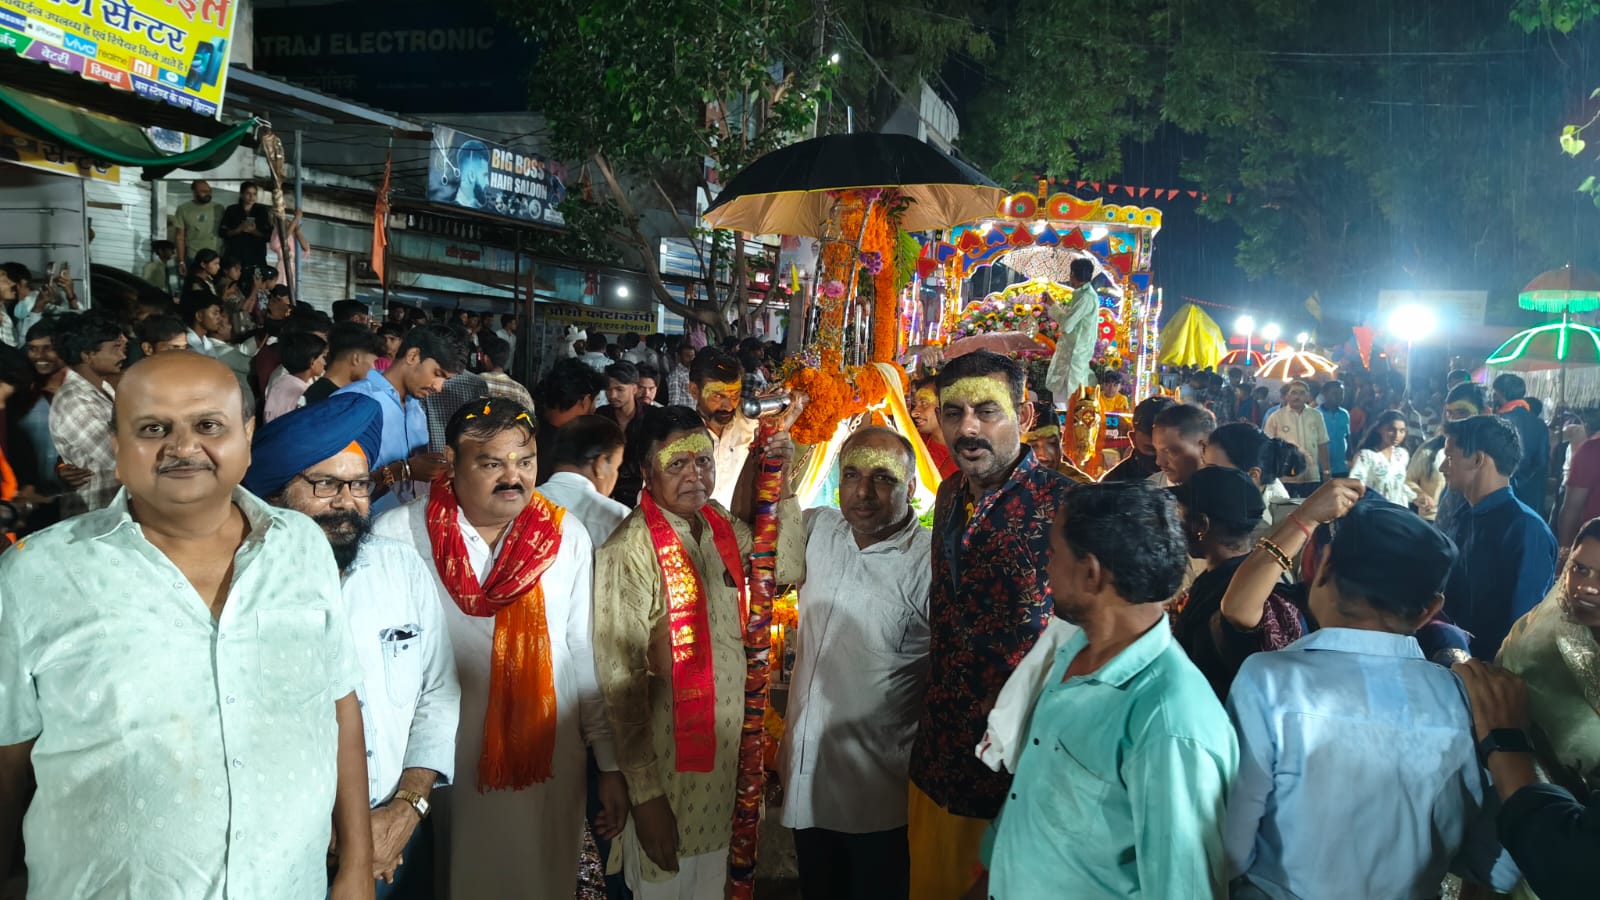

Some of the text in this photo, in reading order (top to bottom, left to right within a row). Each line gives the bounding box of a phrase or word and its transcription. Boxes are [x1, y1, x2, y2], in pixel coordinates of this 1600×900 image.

[328, 26, 495, 56] ELECTRONIC
[491, 148, 546, 180] BIG BOSS
[490, 172, 548, 200] HAIR SALOON
